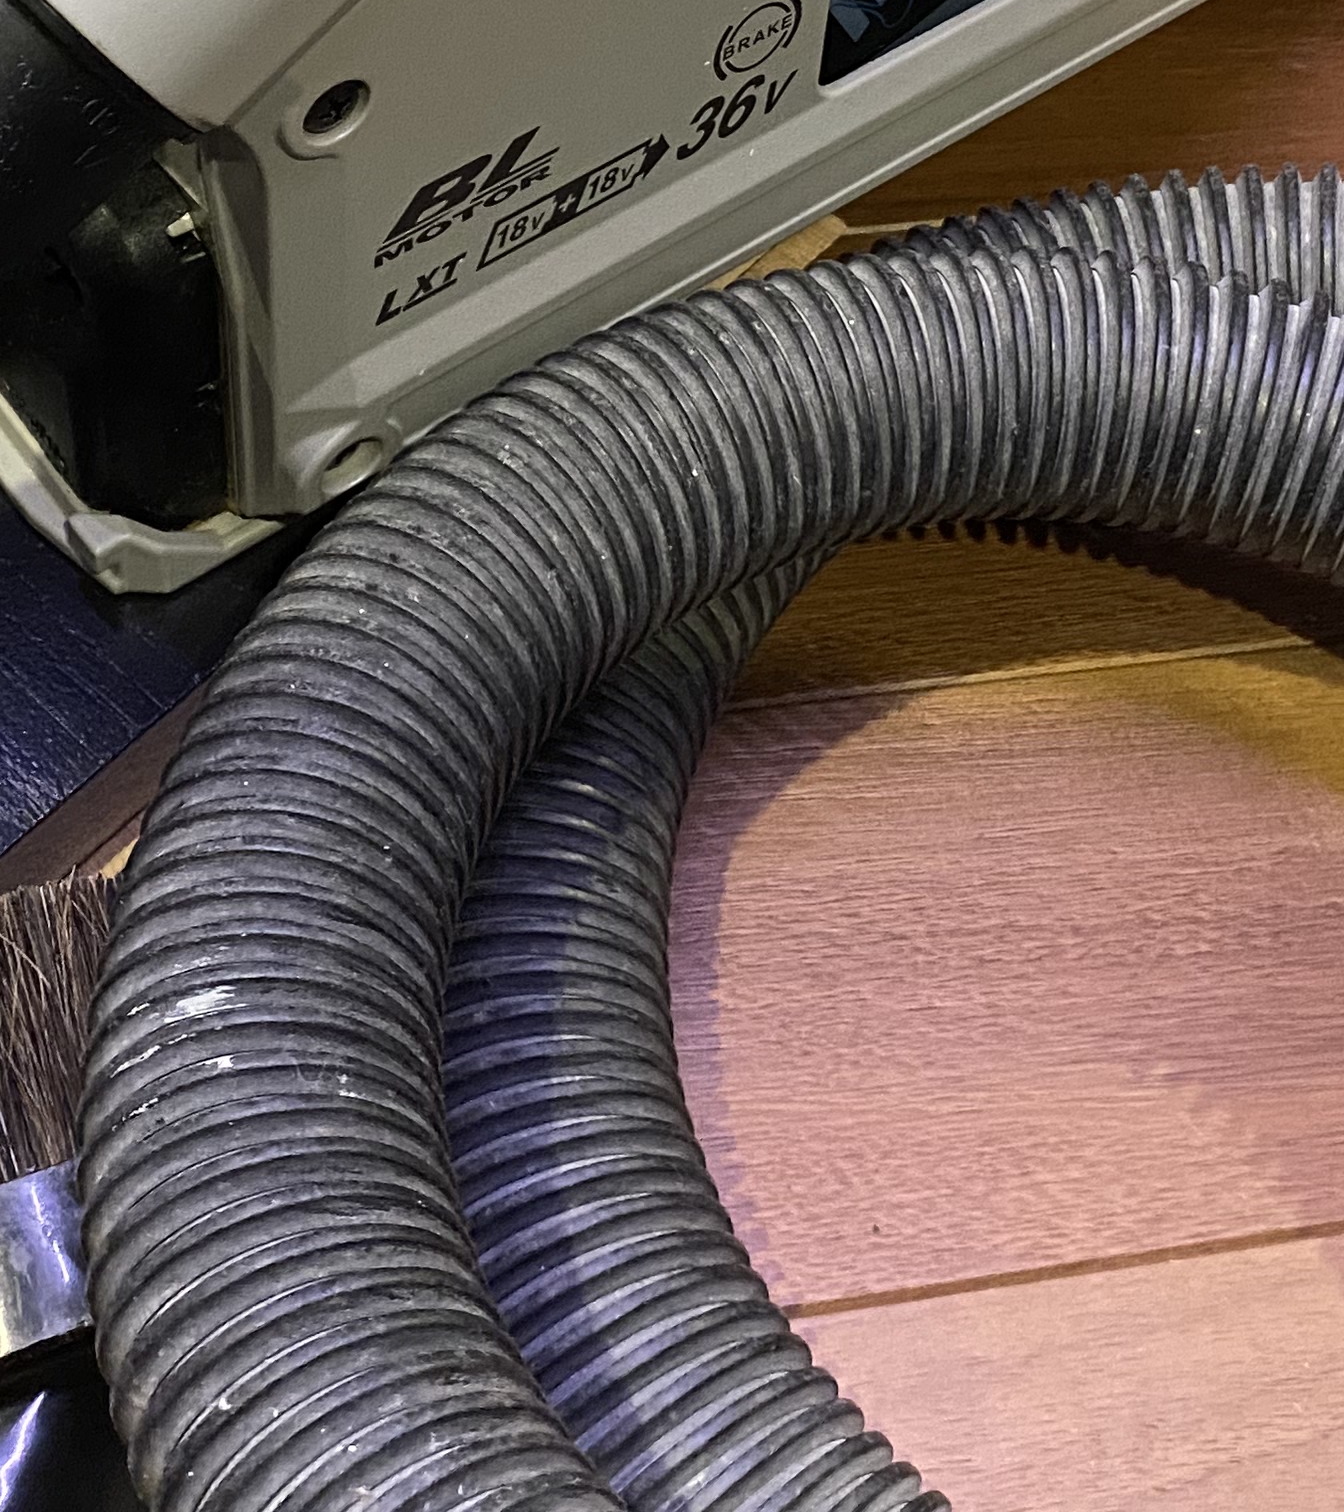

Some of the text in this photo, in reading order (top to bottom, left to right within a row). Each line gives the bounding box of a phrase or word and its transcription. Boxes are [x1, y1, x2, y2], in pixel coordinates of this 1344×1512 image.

[722, 13, 793, 62] BRAKE
[374, 165, 553, 269] MOTOR
[382, 125, 561, 245] BL
